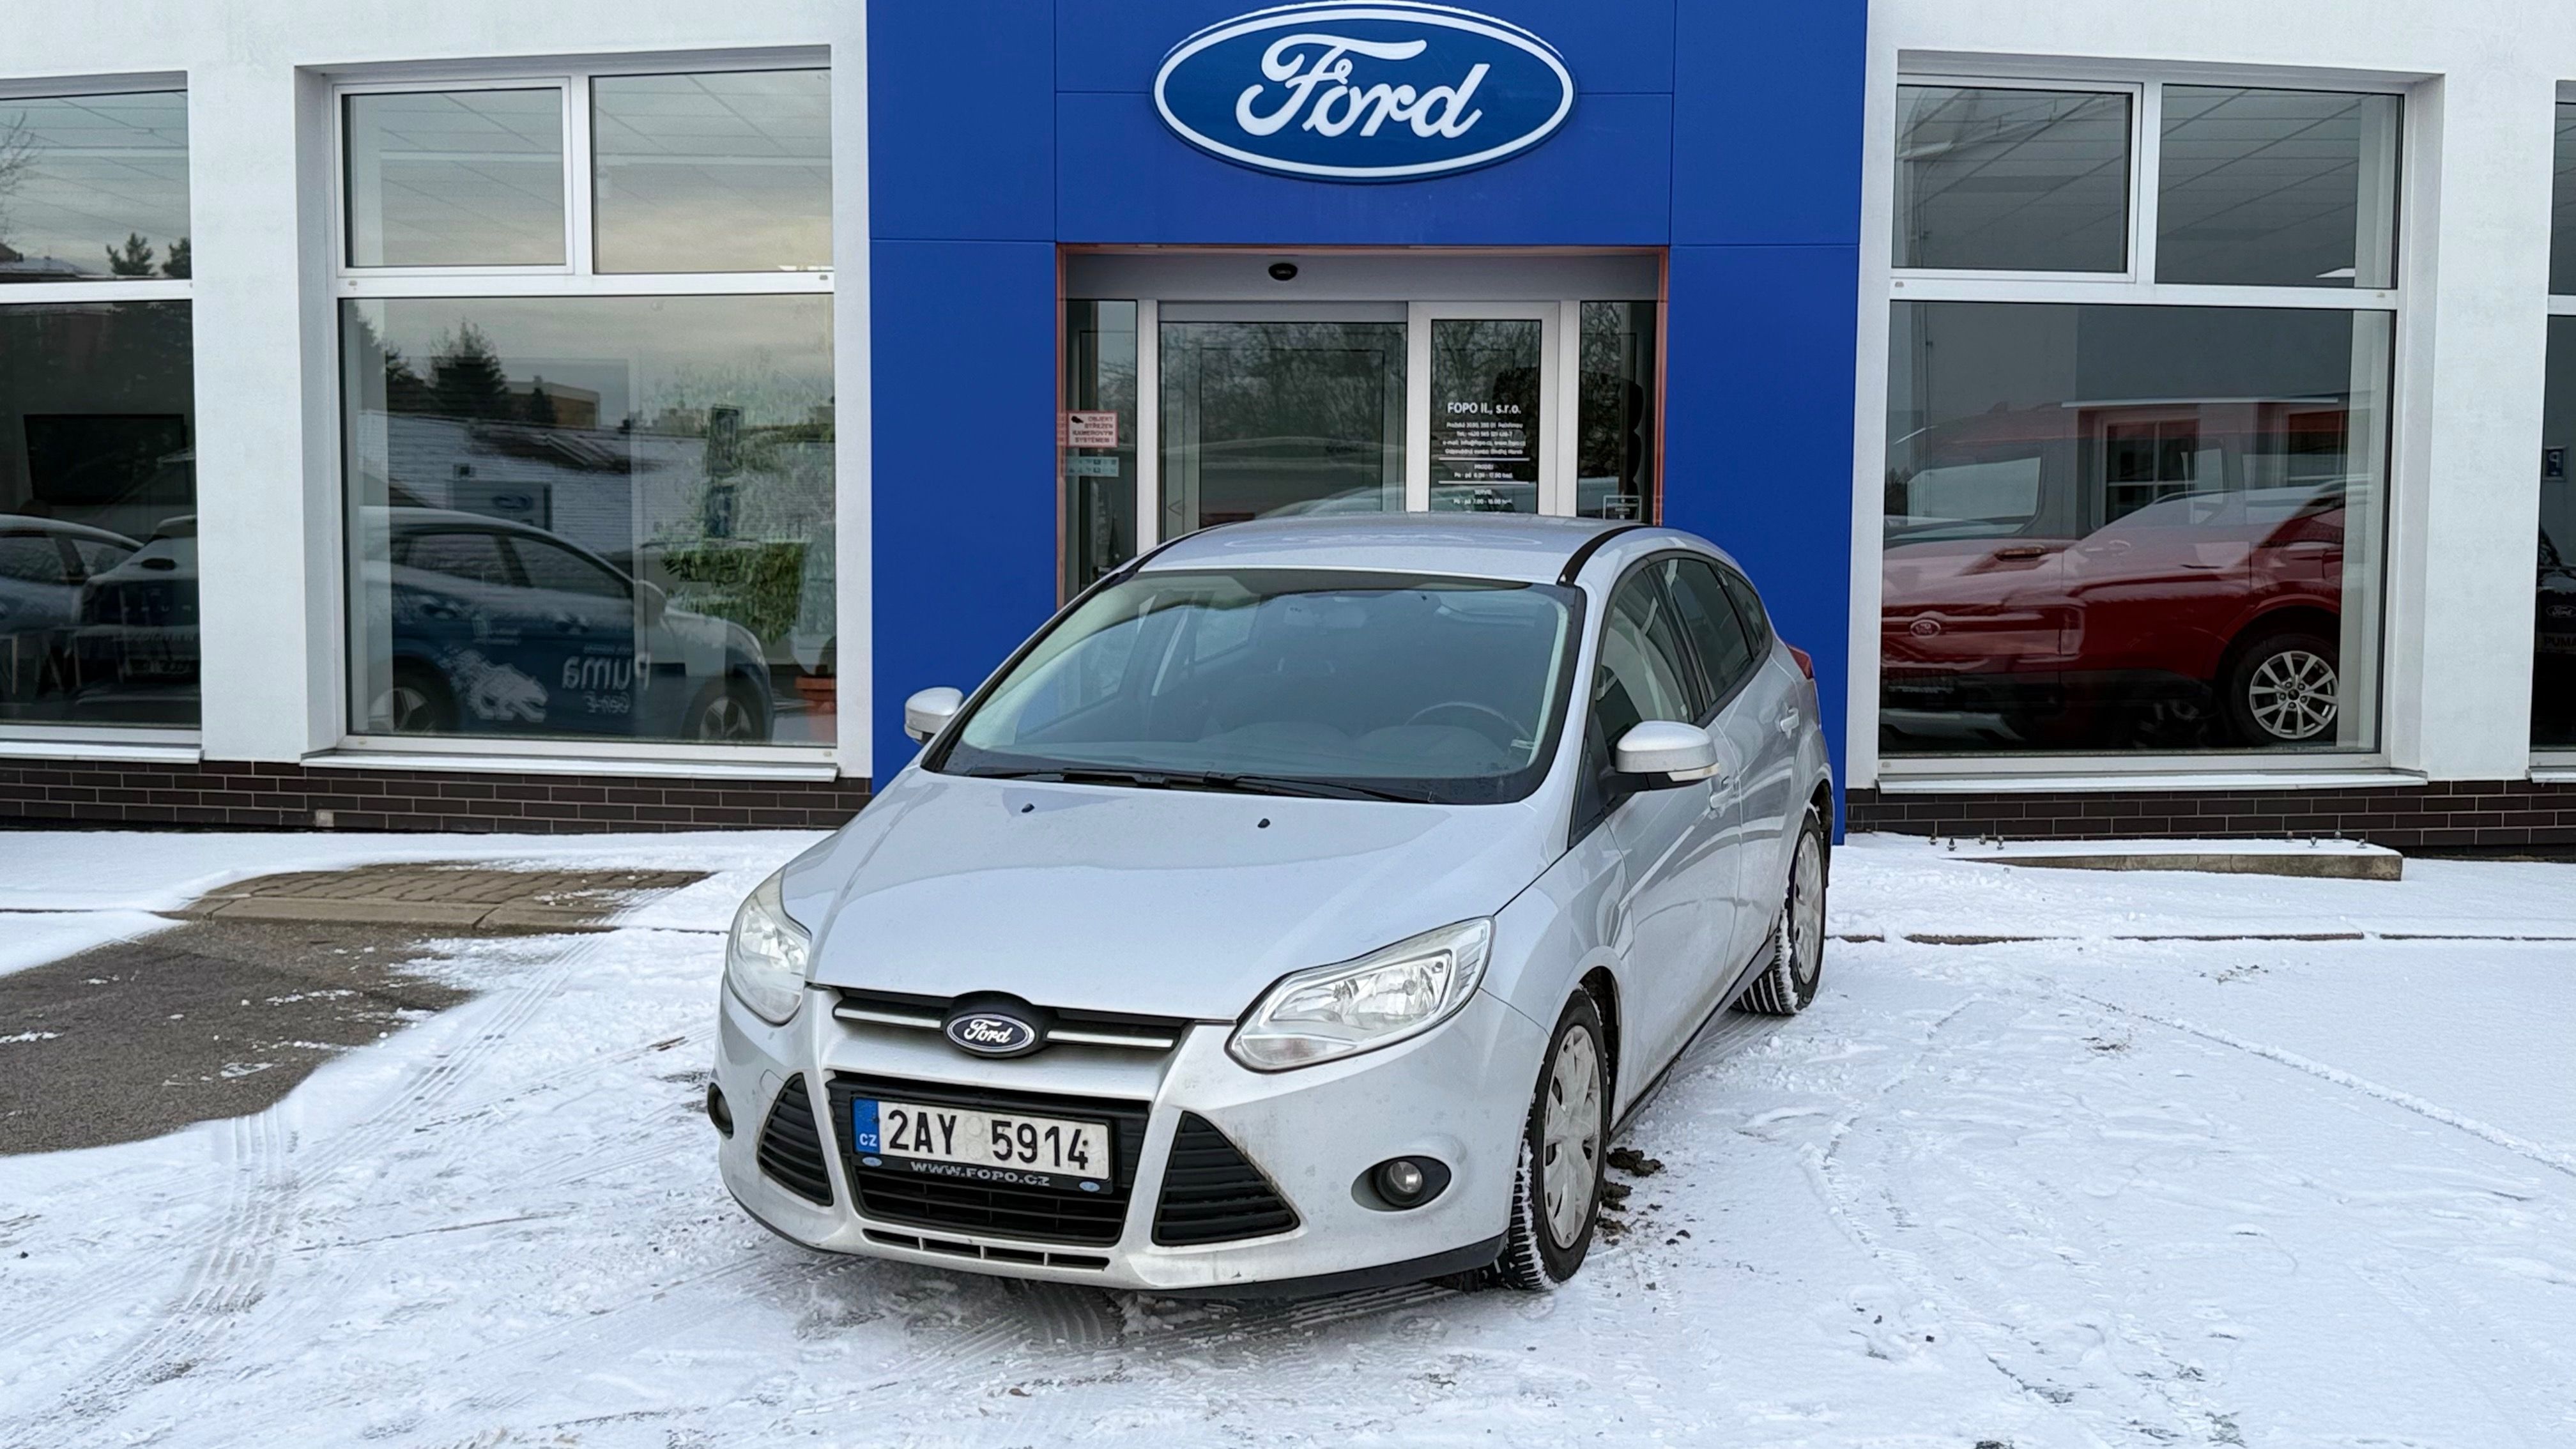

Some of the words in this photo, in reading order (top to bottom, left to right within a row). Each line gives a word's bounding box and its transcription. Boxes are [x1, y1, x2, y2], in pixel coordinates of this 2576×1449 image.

[1236, 34, 1490, 138] Ford
[1447, 402, 1478, 414] FOPO
[1496, 404, 1521, 414] s.r.o.
[964, 1019, 1013, 1044] Ford
[859, 1132, 878, 1147] CZ
[888, 1110, 957, 1155] 2AY
[992, 1119, 1089, 1170] 5914
[910, 1160, 1051, 1187] WWW.FOPO.CZ
